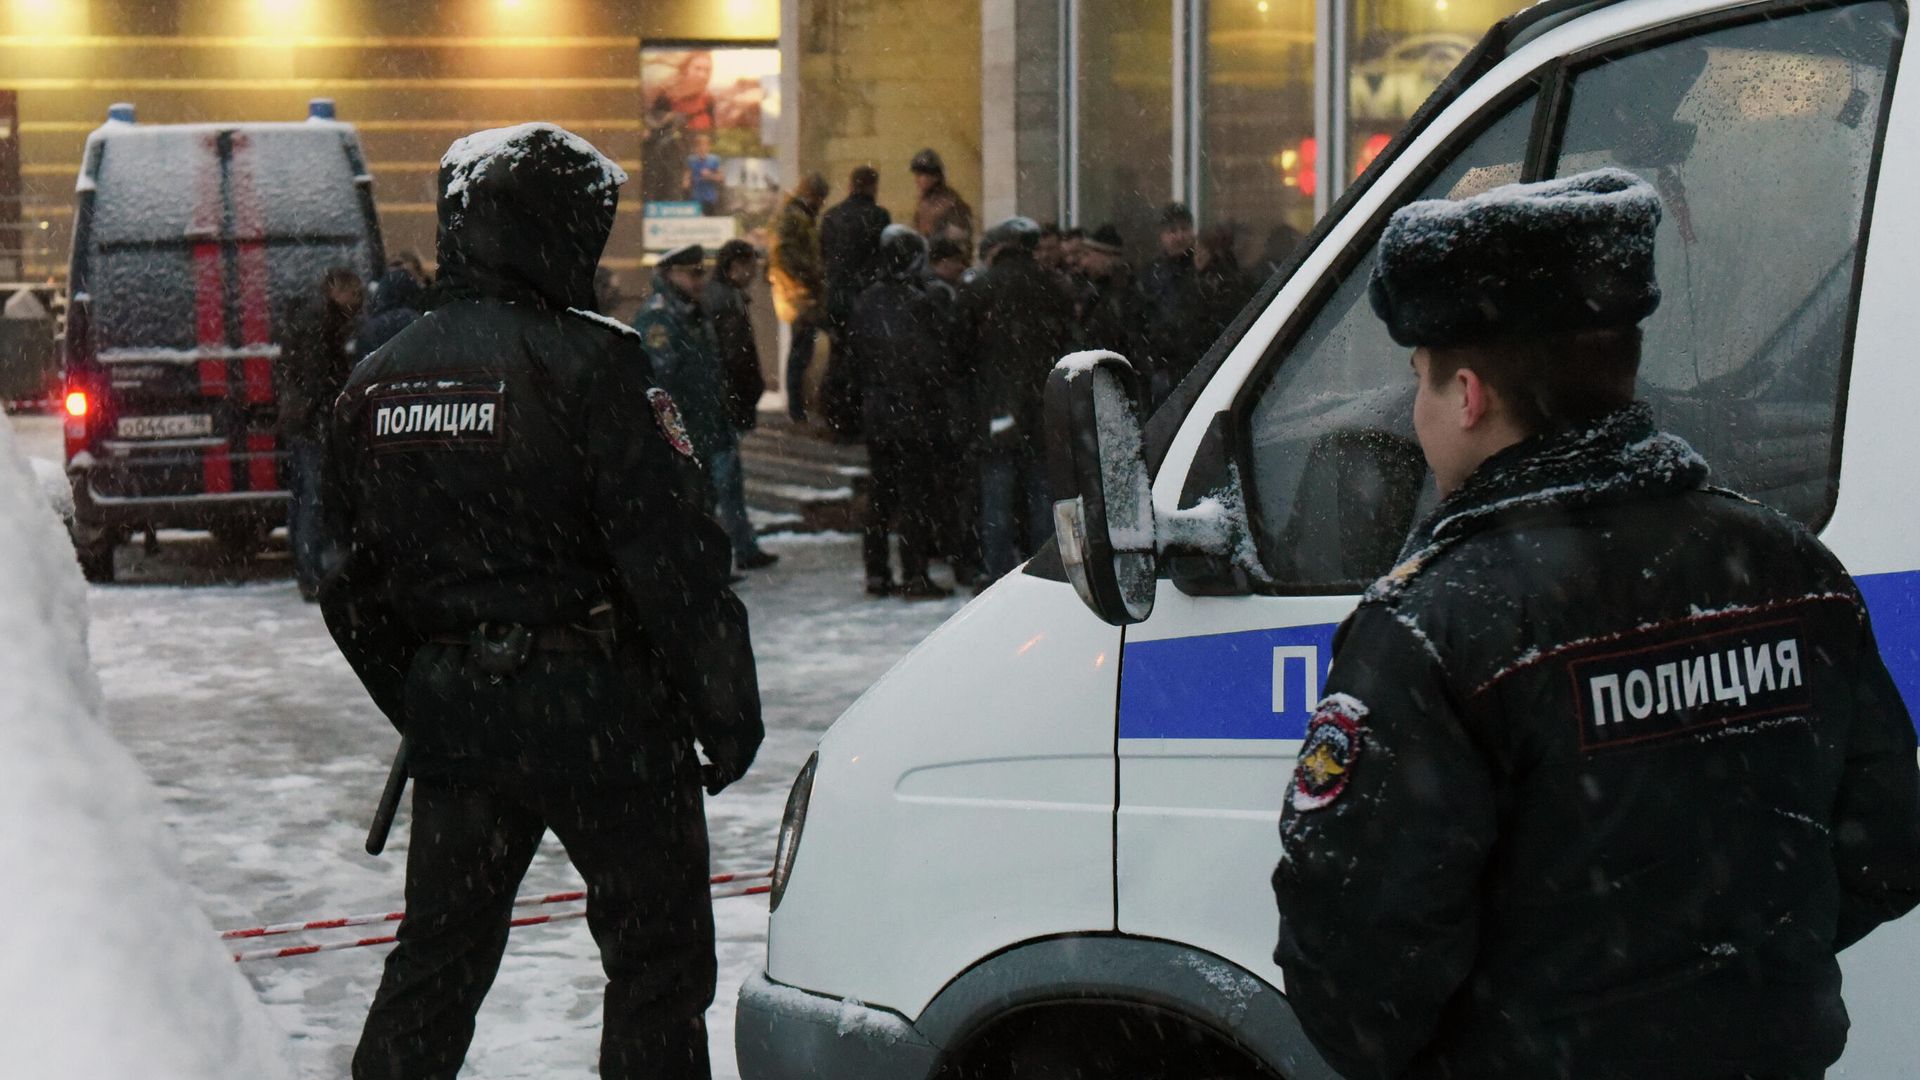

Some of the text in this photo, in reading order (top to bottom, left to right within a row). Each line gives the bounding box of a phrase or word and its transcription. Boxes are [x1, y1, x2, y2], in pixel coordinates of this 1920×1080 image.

[376, 403, 495, 436] ПОЛИЦИЯ
[1272, 645, 1334, 713] П
[1589, 638, 1803, 726] ПОЛИЦИЯ
